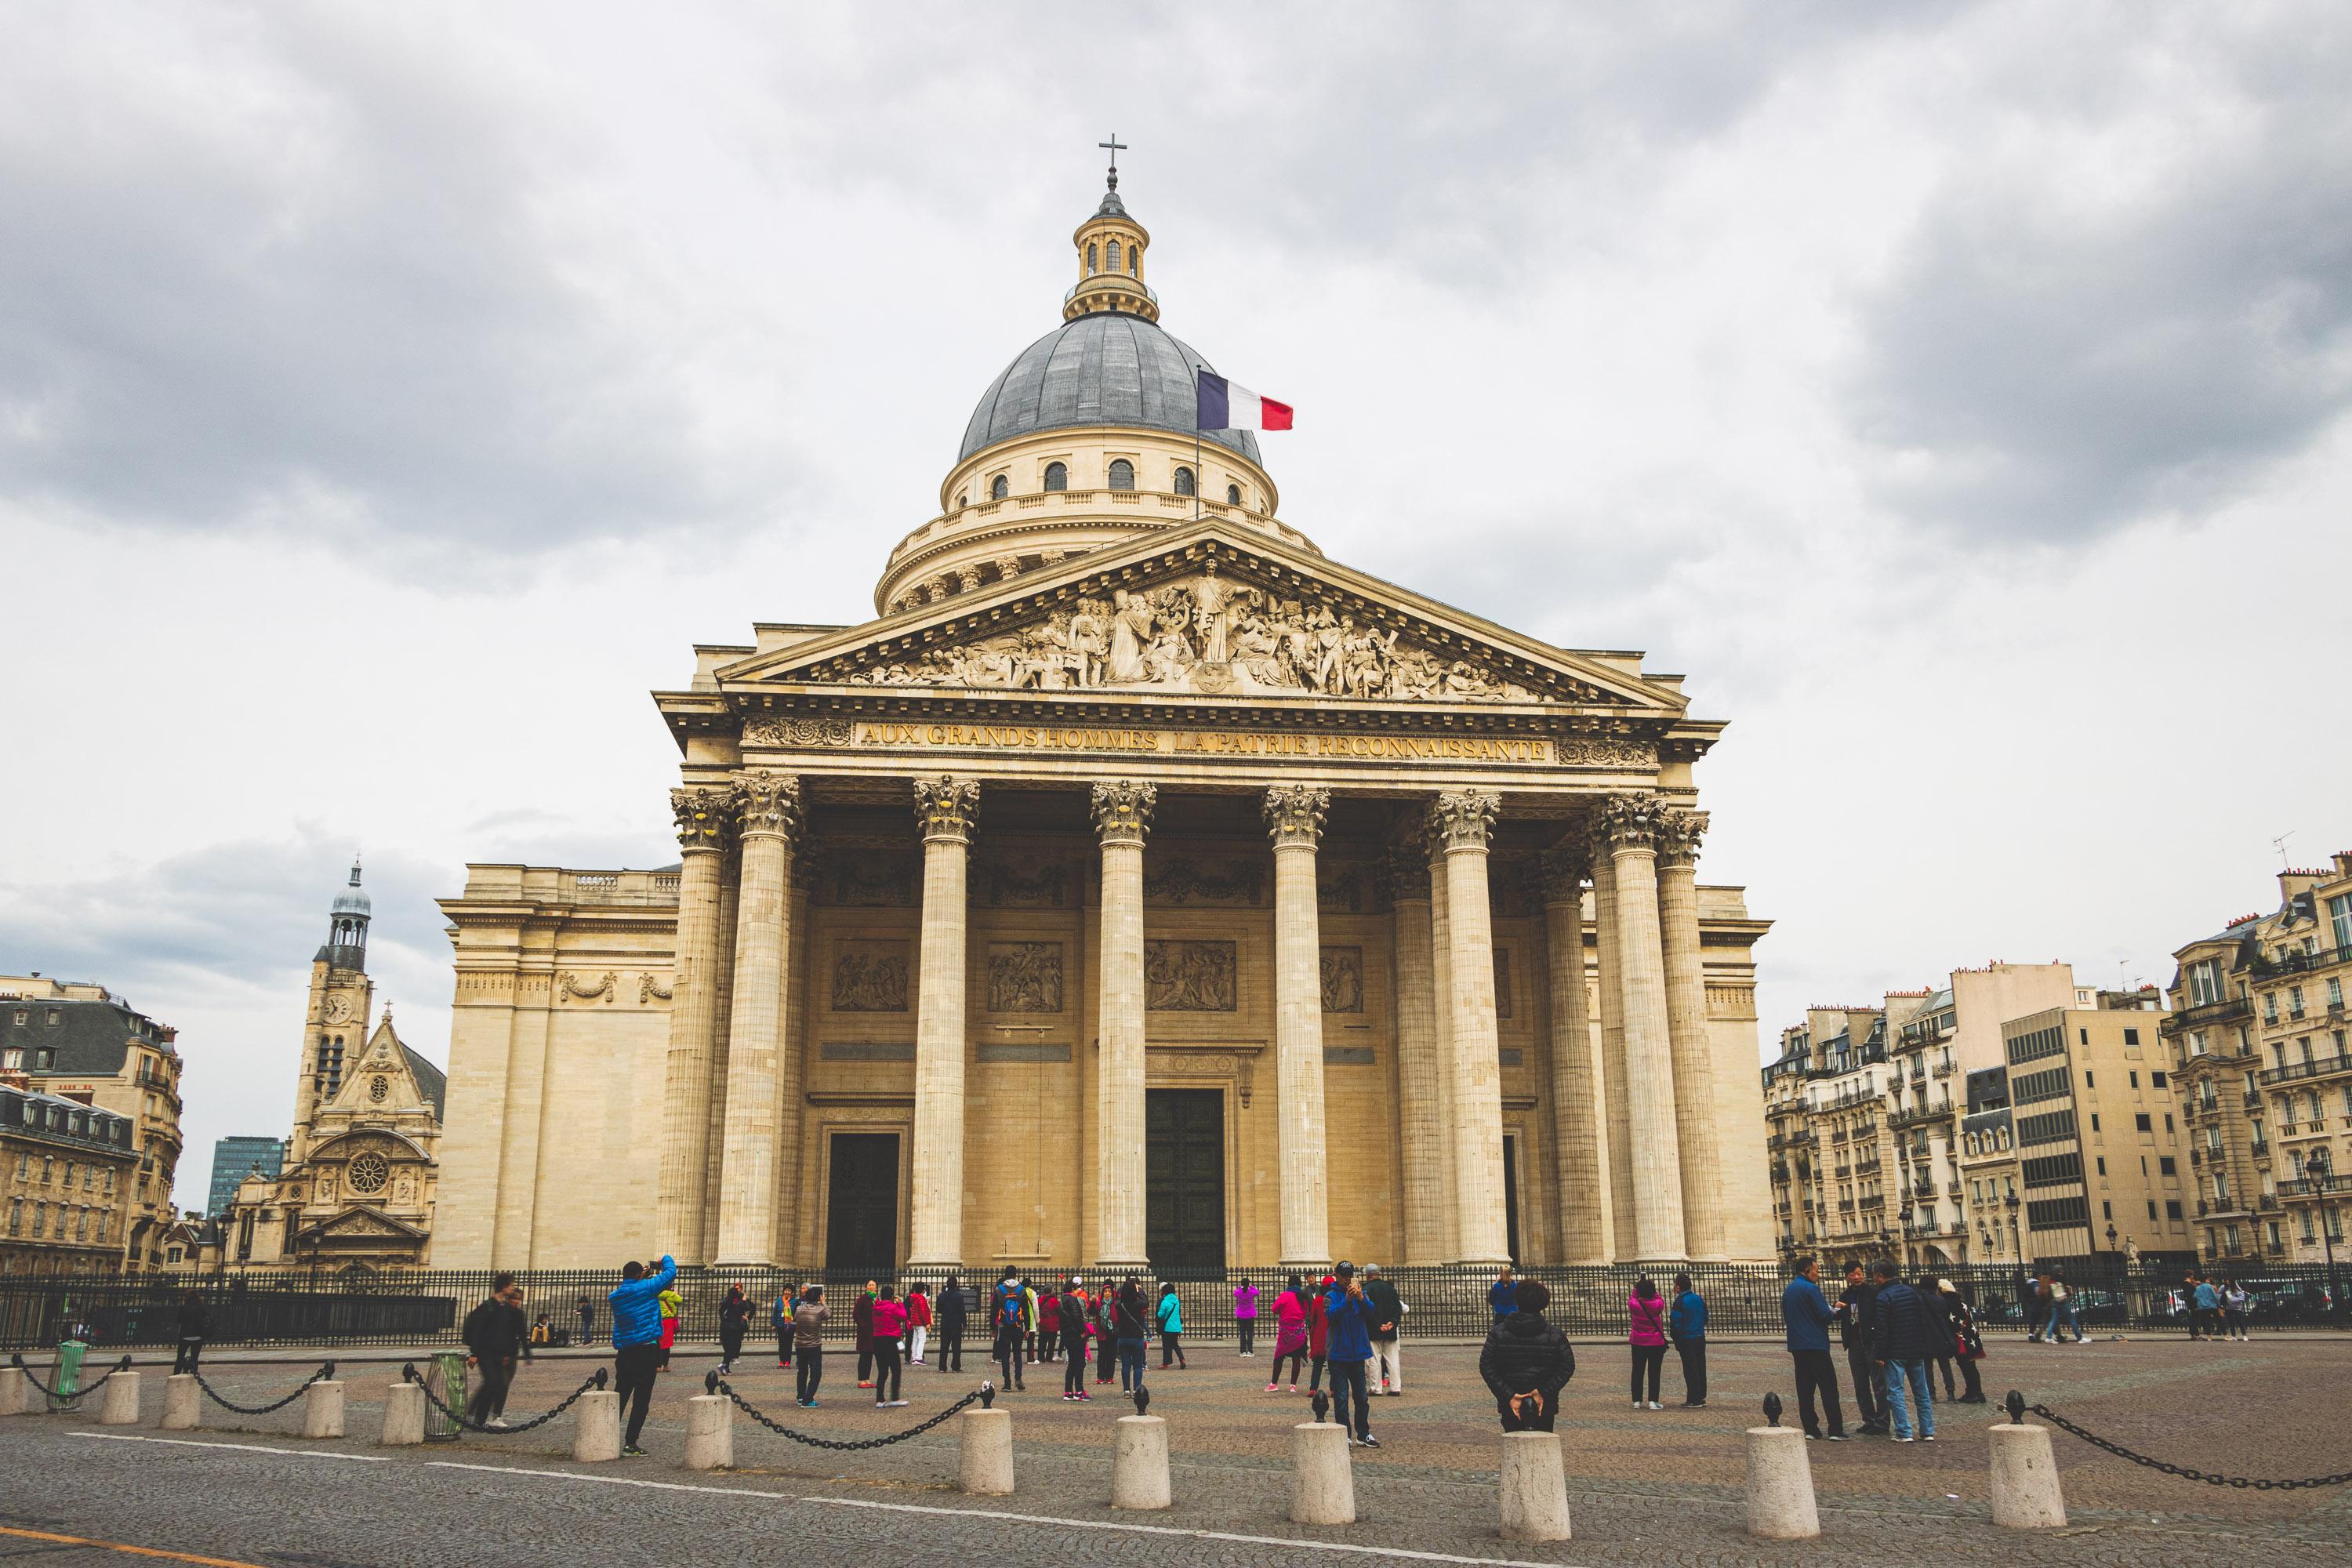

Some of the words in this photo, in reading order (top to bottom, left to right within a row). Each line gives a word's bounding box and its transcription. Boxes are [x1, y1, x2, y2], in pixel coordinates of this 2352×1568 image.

[860, 724, 920, 743] AUX
[927, 724, 1039, 746] GRANDS
[1044, 728, 1159, 750] HOMMES
[1174, 731, 1209, 752] LA
[1215, 733, 1309, 754] PATRIE
[1317, 735, 1546, 760] RECONNAISSANTE
